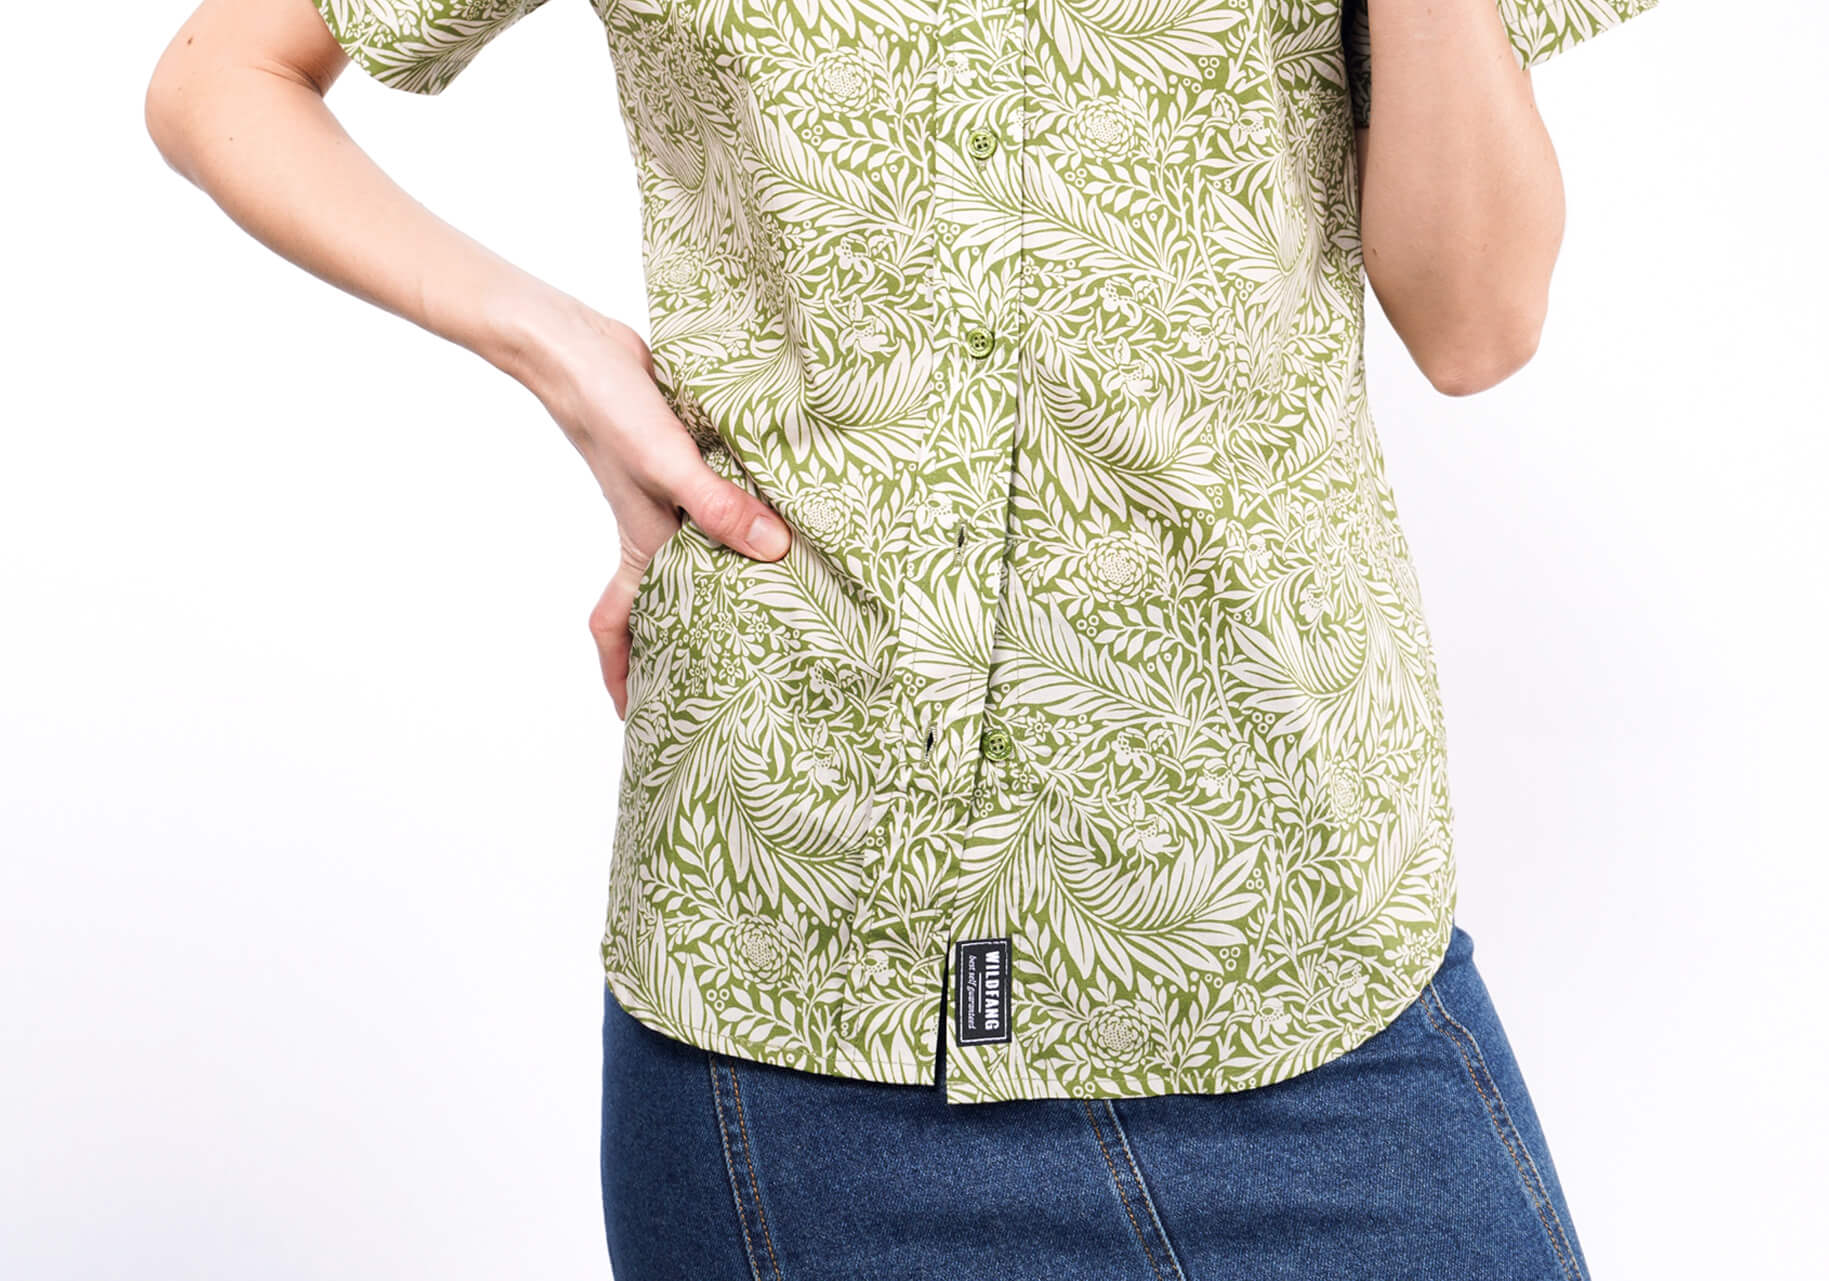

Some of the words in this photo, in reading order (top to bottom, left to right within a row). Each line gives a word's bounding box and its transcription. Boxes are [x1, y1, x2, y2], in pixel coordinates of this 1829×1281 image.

[968, 954, 977, 971] best
[967, 972, 977, 987] self
[984, 950, 1000, 1030] WILDFANG
[966, 985, 977, 1030] guaranteed
